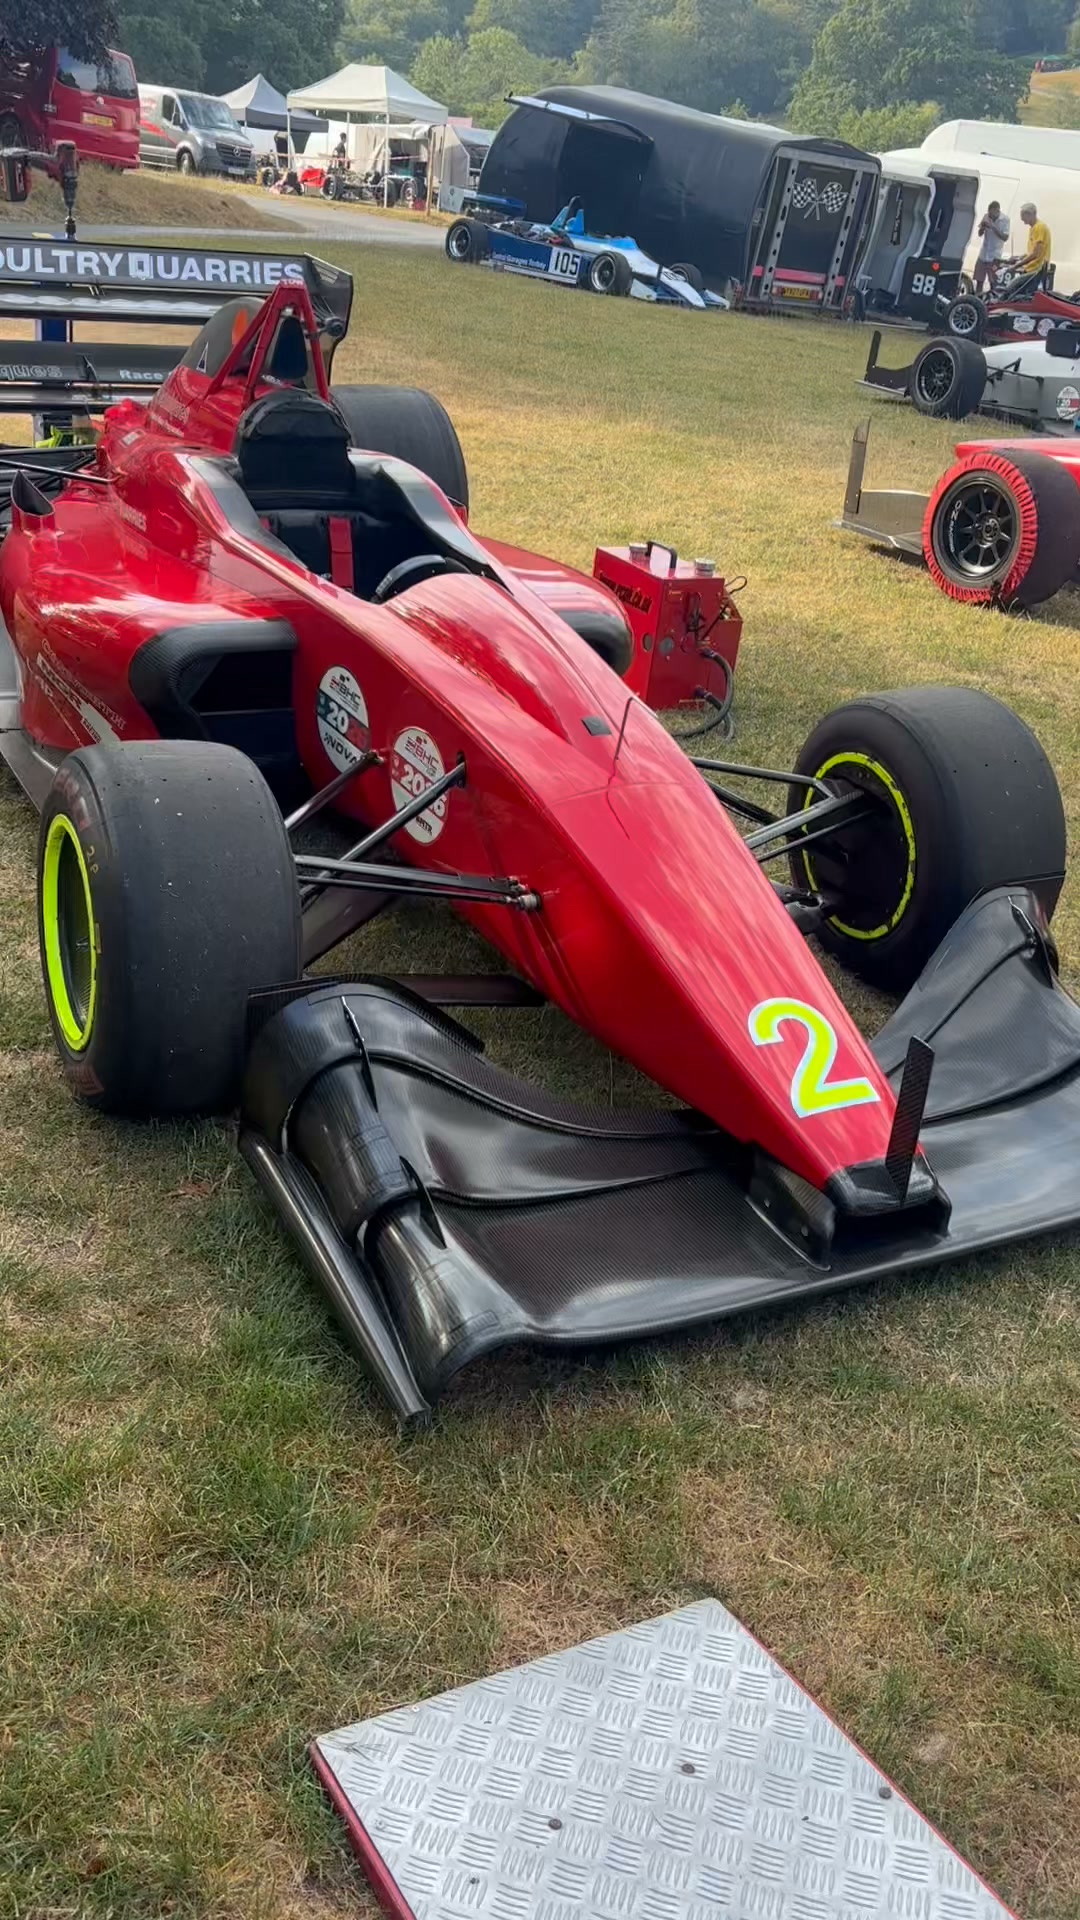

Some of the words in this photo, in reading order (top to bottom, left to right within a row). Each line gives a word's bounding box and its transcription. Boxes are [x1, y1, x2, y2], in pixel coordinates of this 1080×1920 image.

[554, 251, 580, 276] 105
[912, 273, 936, 296] 98
[119, 369, 164, 381] Race
[951, 500, 962, 520] OZ
[747, 996, 881, 1118] 2
